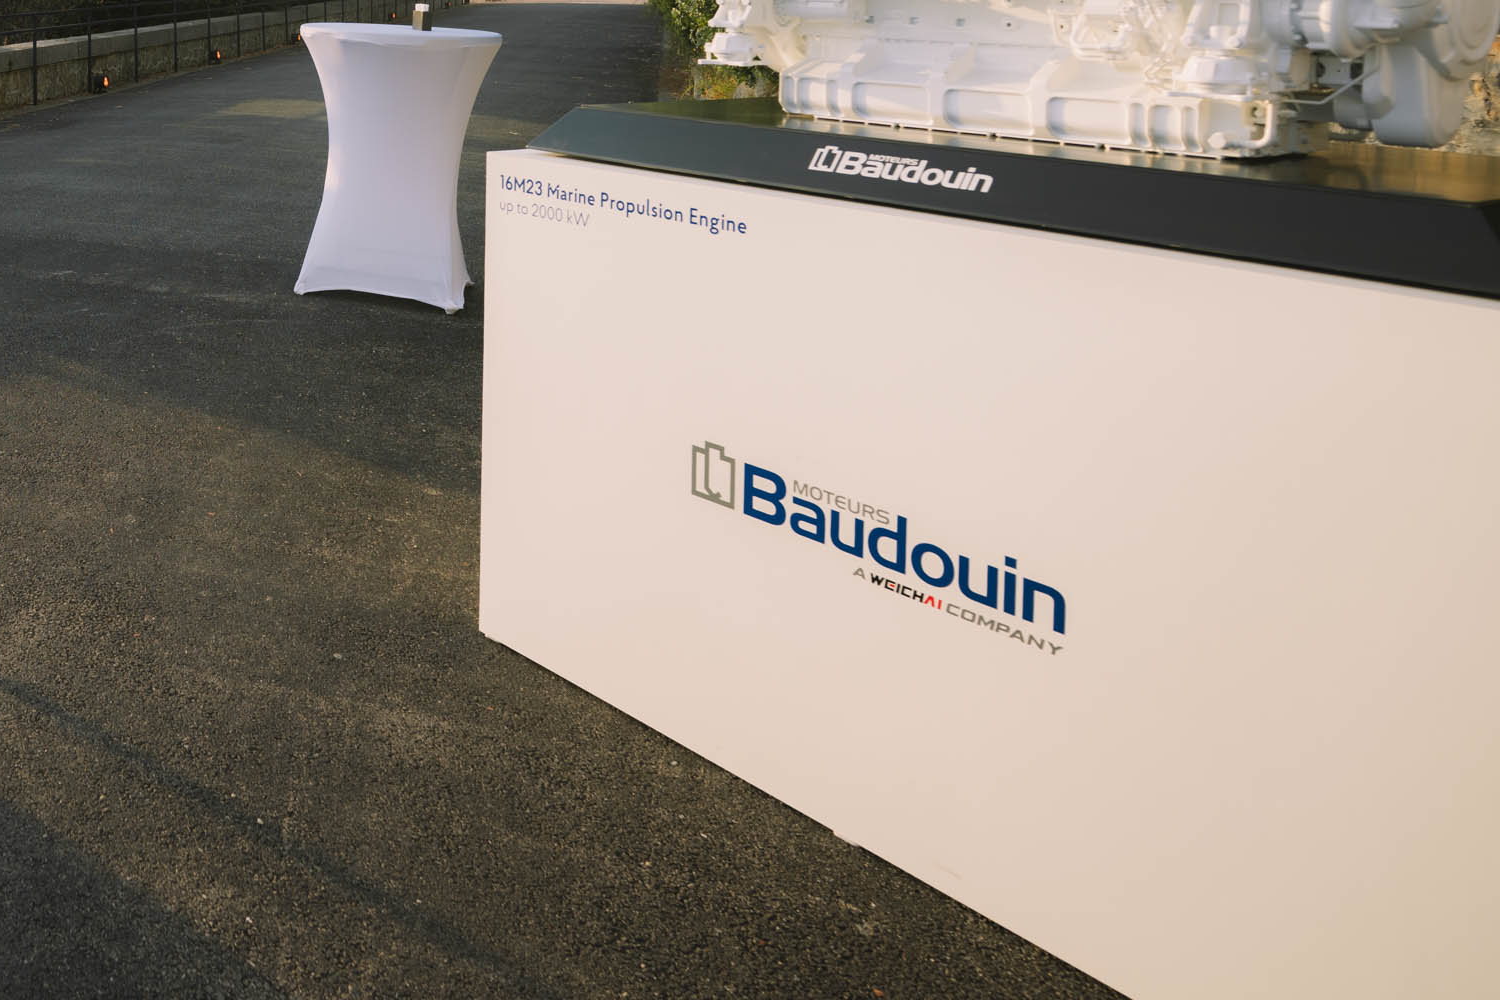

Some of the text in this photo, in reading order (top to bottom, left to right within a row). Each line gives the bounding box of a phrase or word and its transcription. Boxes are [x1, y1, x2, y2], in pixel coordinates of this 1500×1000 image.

[835, 150, 994, 194] Baudouin
[868, 153, 919, 166] MOTEURS
[499, 174, 747, 235] 16M23 Marine Propulsion Engine
[499, 201, 590, 228] up to 2000 kW
[792, 479, 891, 526] MOTEURS
[742, 462, 1066, 636] Baudouin
[852, 567, 1064, 656] A WEICHAI COMPANY
